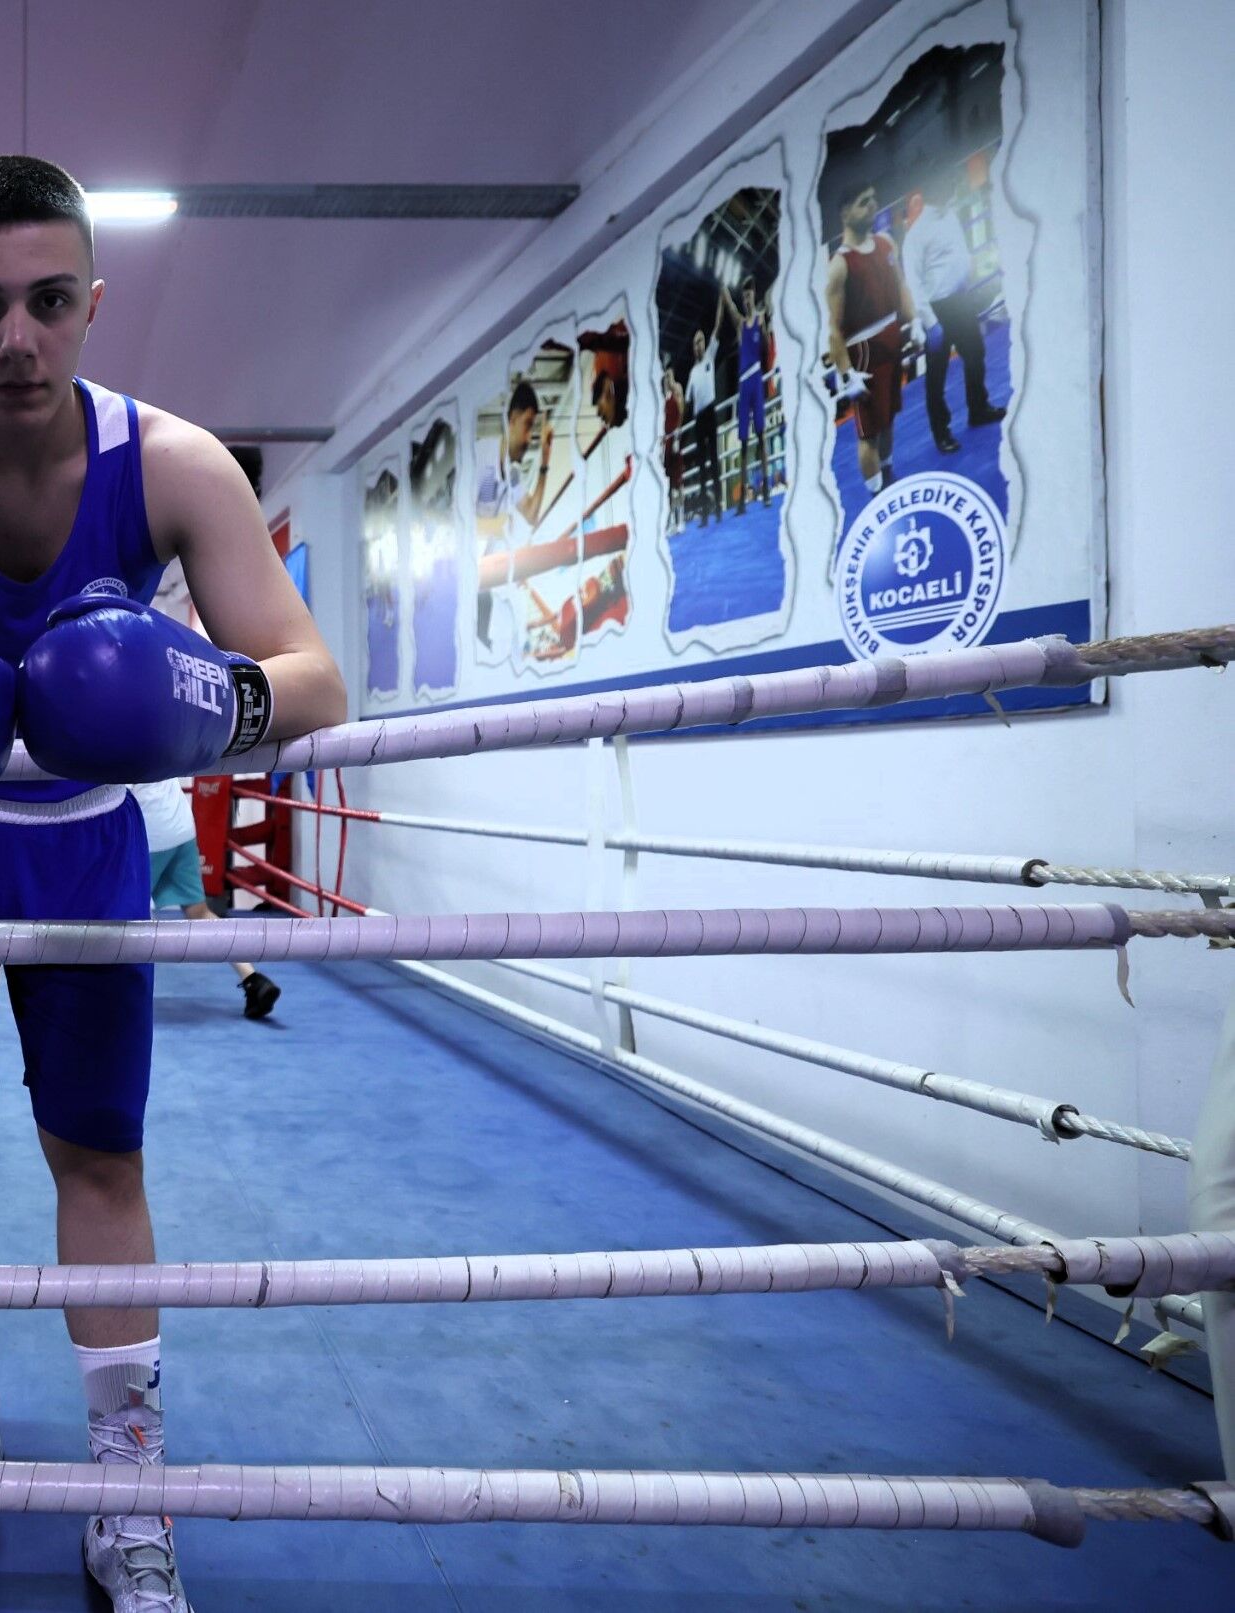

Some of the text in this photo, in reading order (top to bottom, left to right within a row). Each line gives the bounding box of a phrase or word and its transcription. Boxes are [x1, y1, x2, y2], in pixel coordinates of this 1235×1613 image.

[876, 485, 966, 524] BELEDİYE
[952, 510, 996, 642] KAĞITSPOR
[869, 571, 962, 611] KOCAELİ
[166, 646, 230, 690] GREEN
[173, 669, 223, 716] HILL
